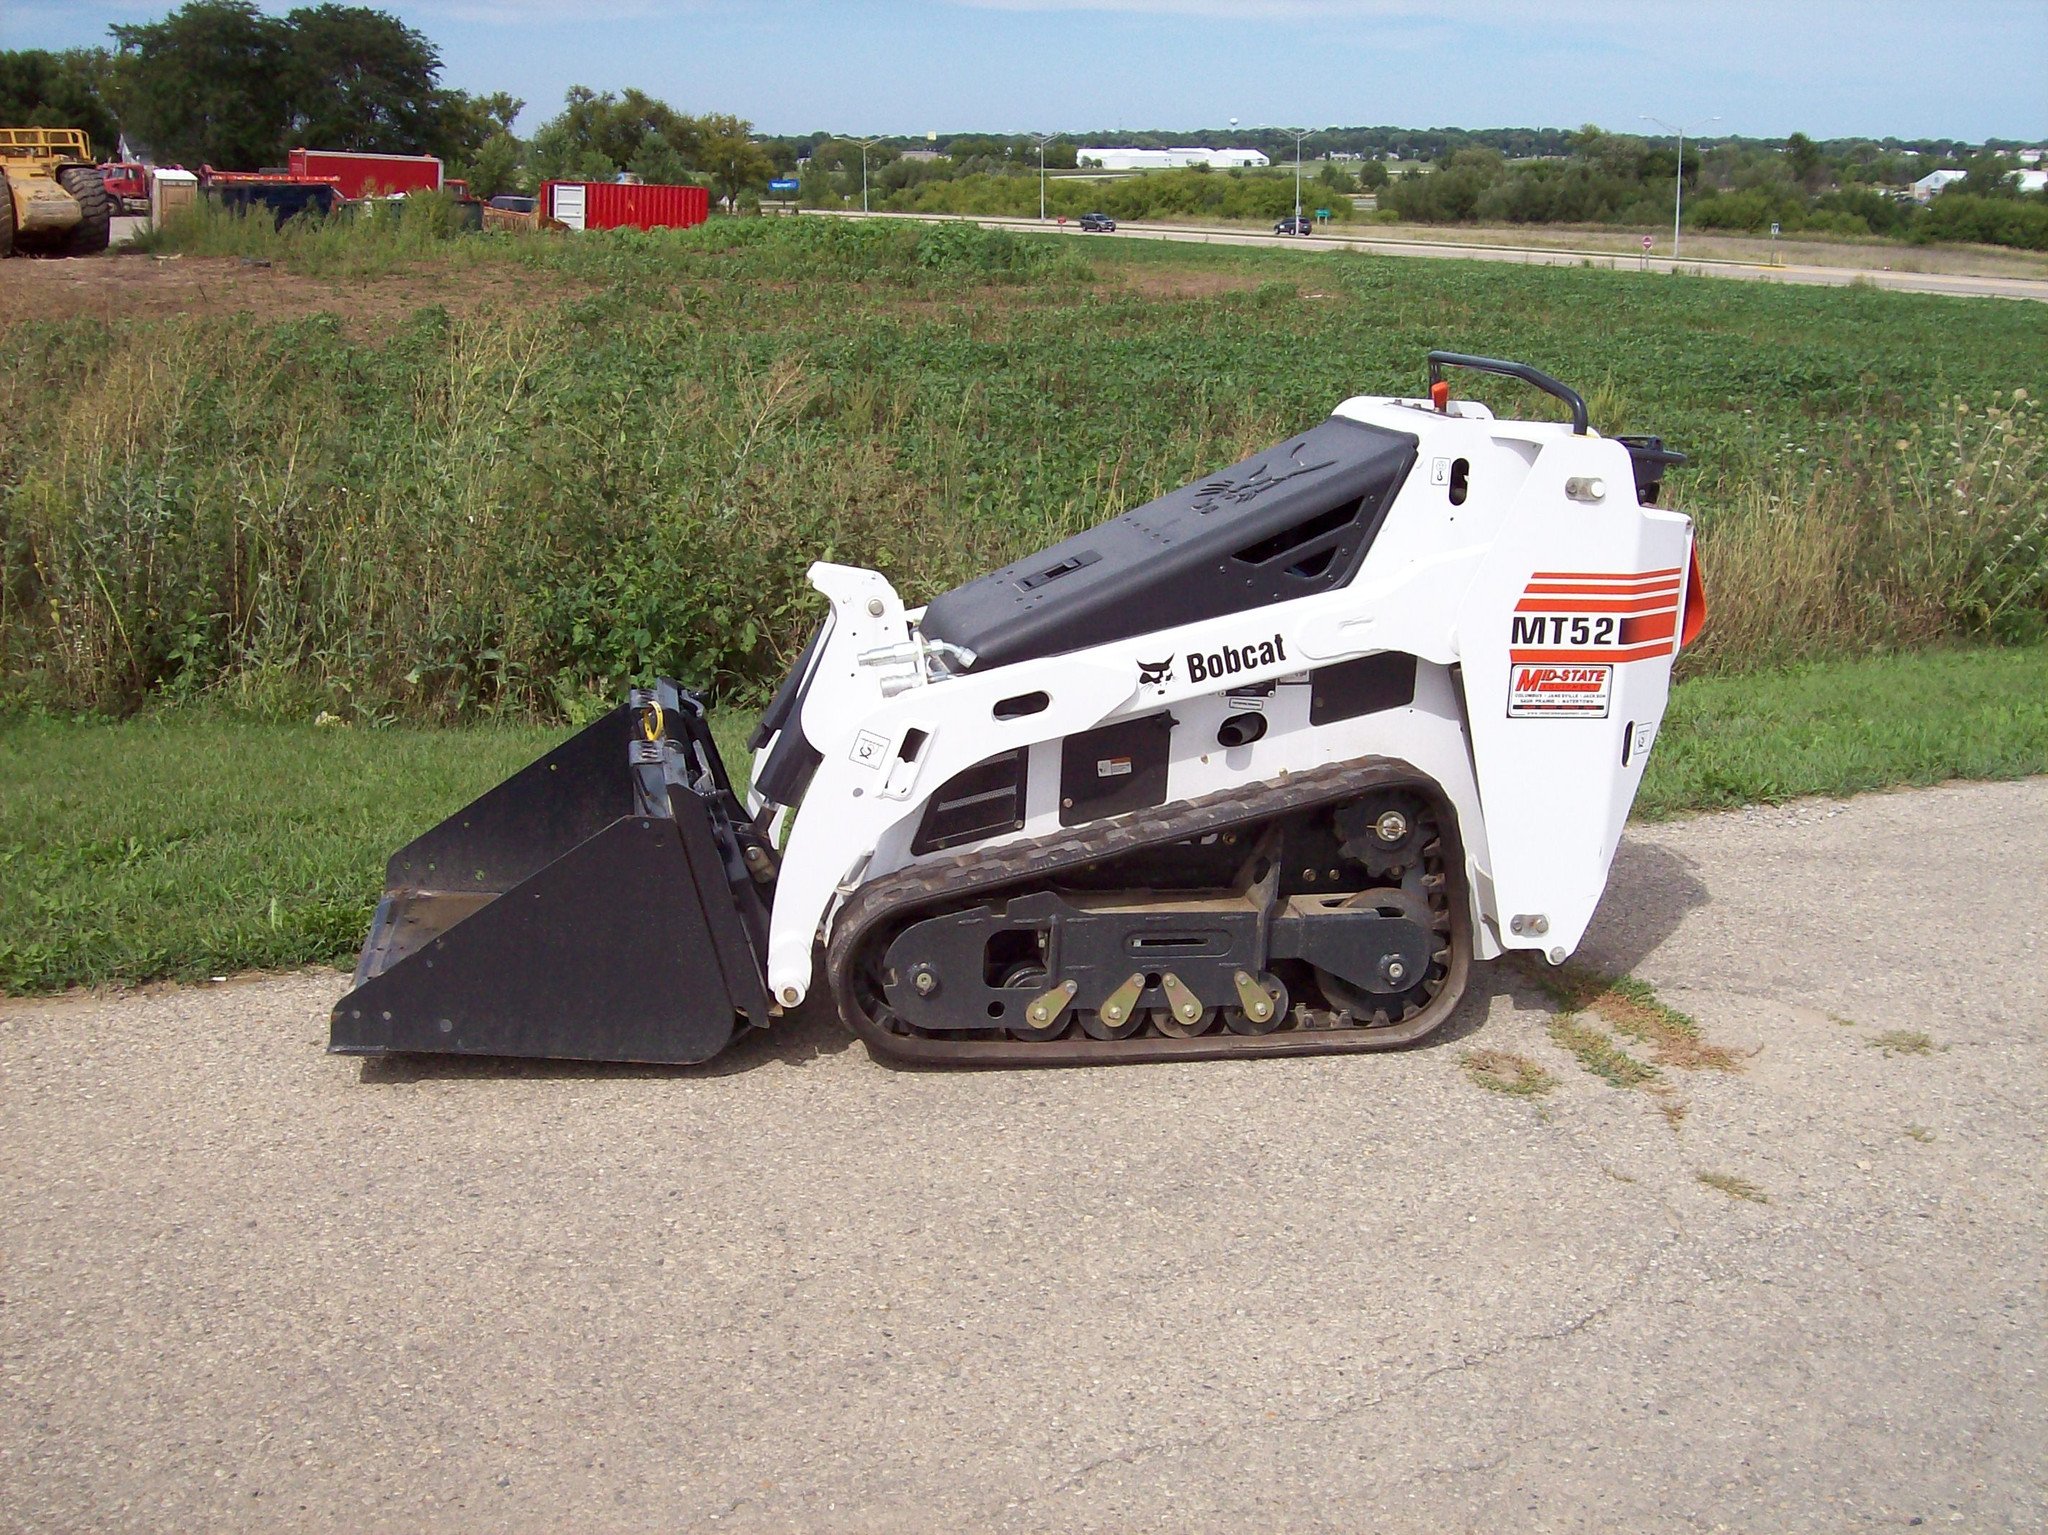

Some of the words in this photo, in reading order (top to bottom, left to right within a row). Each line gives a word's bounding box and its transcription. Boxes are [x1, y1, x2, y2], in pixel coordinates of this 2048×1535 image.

[1512, 617, 1614, 644] MT52
[1187, 634, 1287, 683] Bobcat
[1515, 669, 1606, 691] MID-STATE
